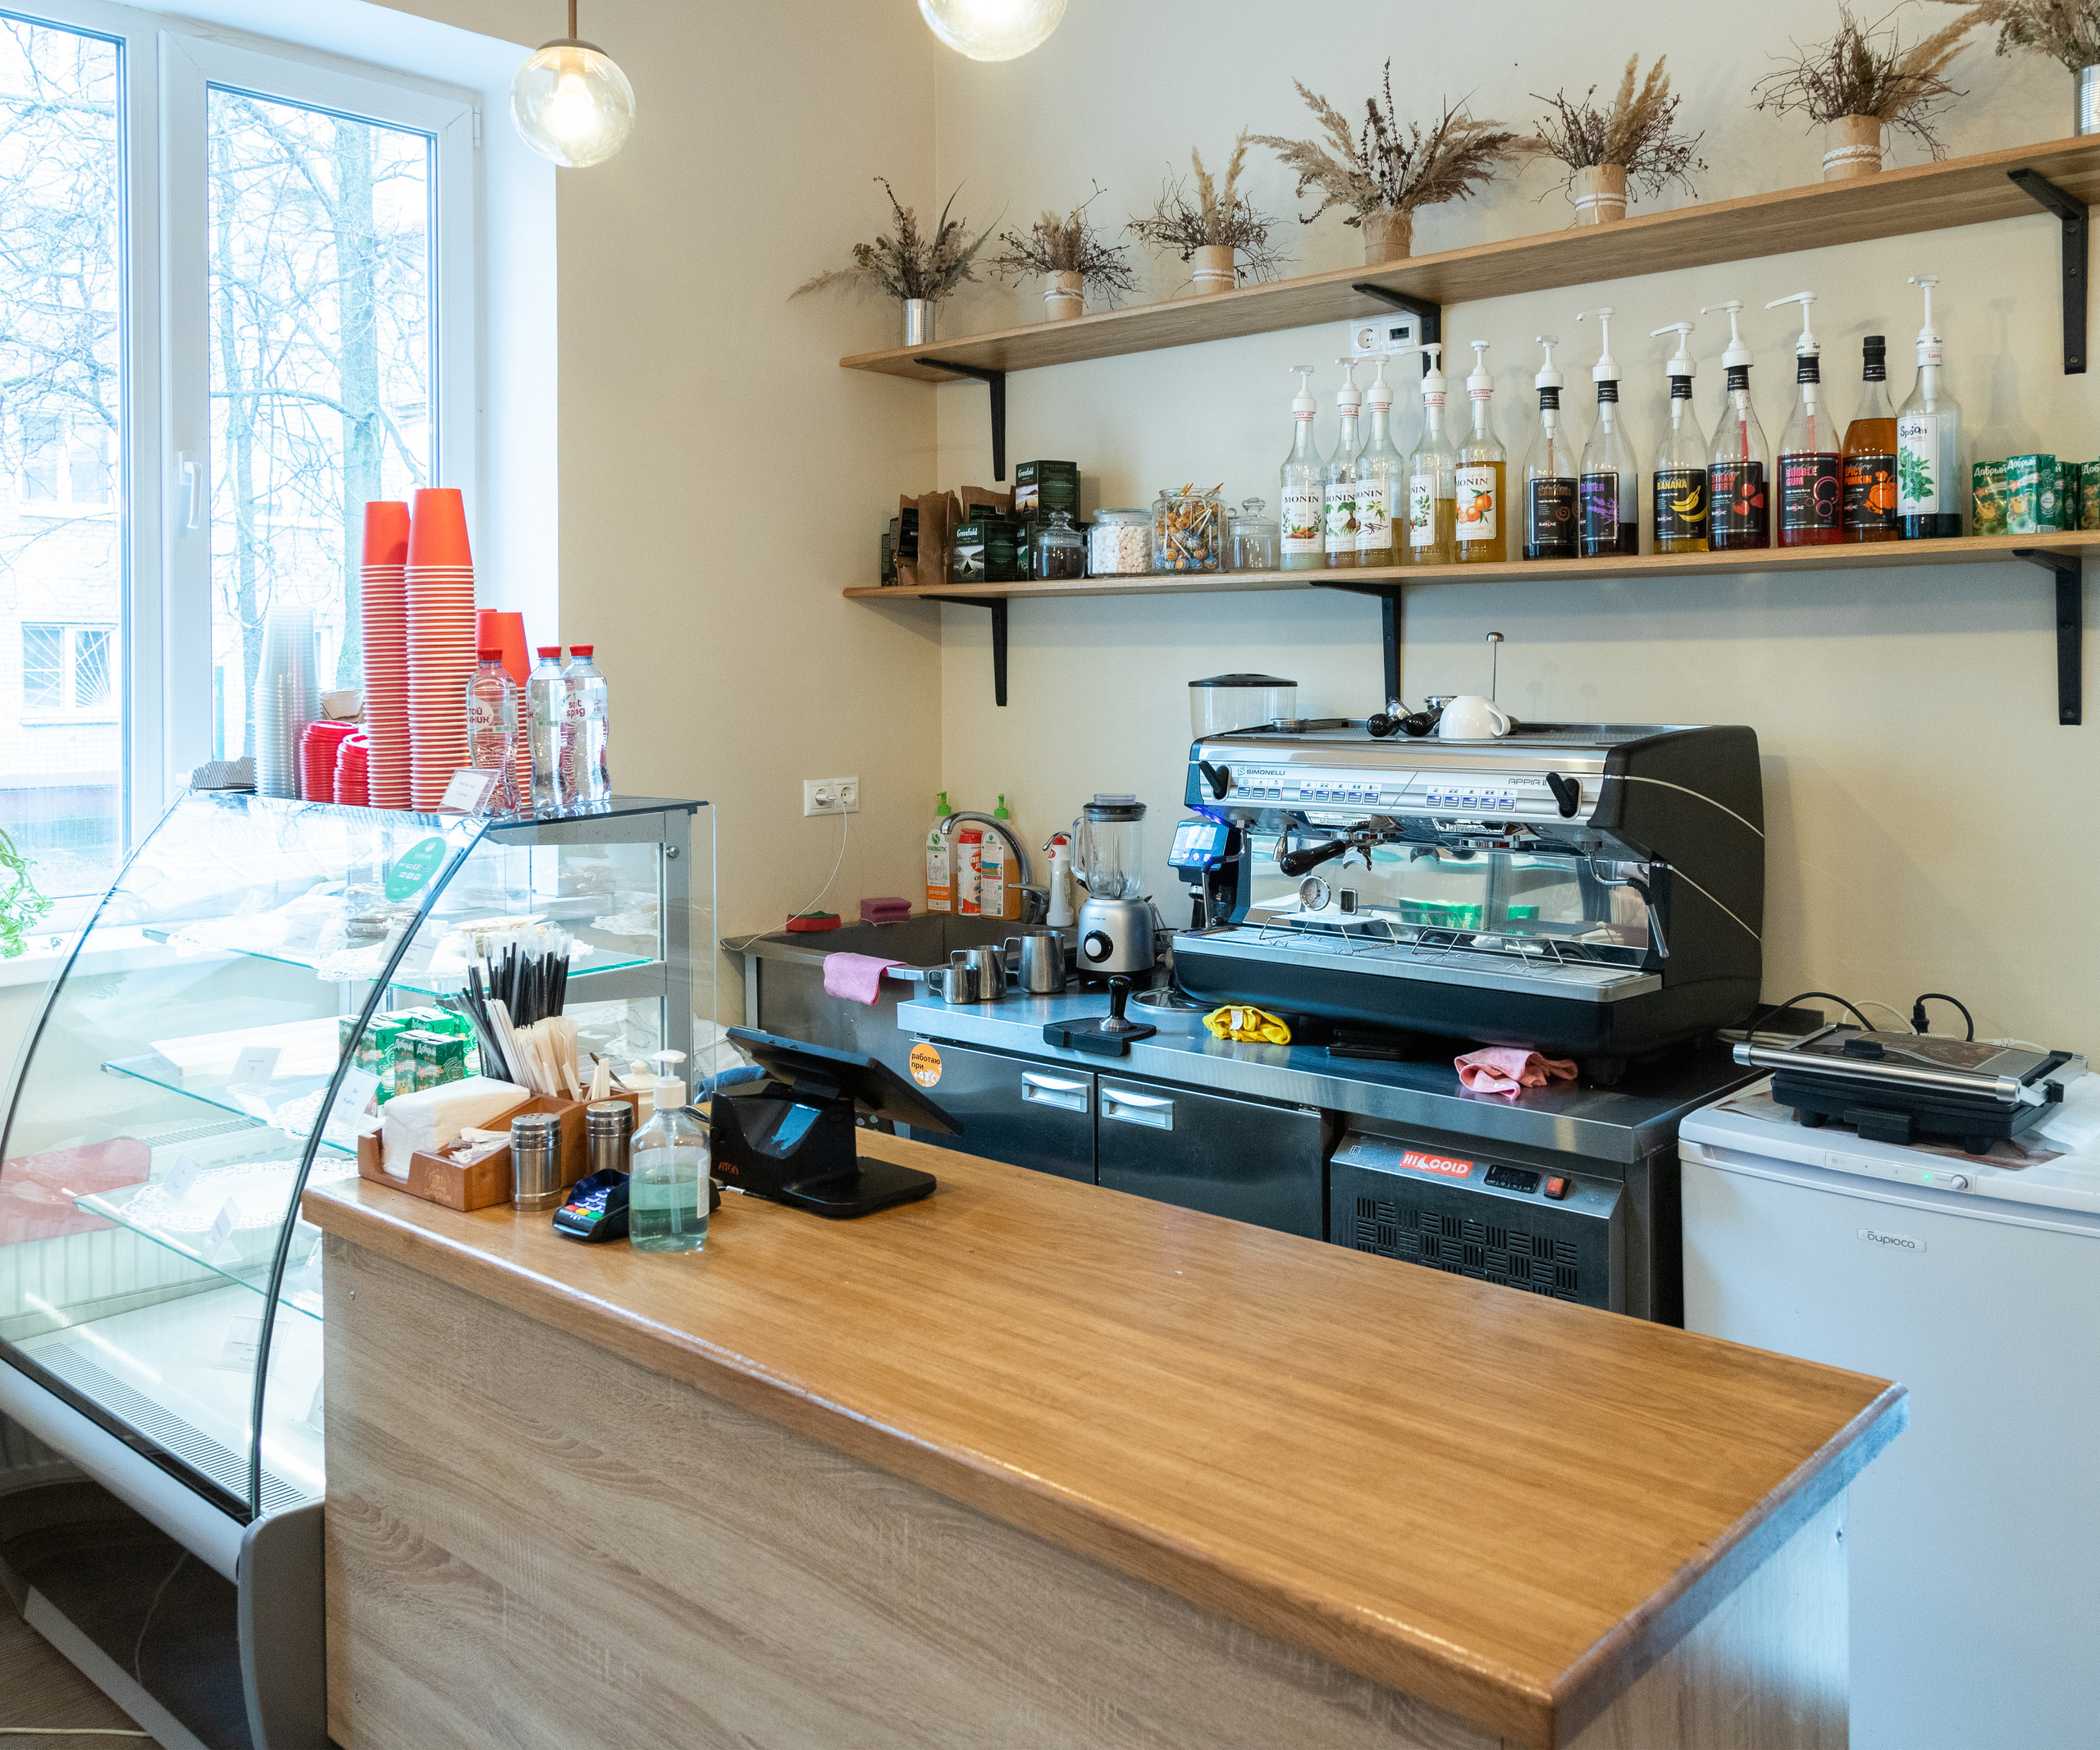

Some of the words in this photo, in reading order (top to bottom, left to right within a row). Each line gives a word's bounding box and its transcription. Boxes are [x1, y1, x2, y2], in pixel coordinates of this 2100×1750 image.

[2006, 456, 2036, 470] Добрый
[1786, 468, 1817, 477] BUBBLE
[1844, 467, 1862, 477] SPICY
[1974, 464, 2007, 477] Добрый
[2083, 464, 2100, 475] Доб
[1711, 474, 1737, 483] STRAW
[1786, 476, 1804, 487] GUM
[1657, 481, 1687, 490] BANANA
[1711, 482, 1733, 492] BERRY
[956, 528, 978, 537] Greenfield
[468, 706, 483, 715] той
[1509, 778, 1541, 786] APPIA
[970, 856, 980, 864] ПЕ
[395, 1038, 414, 1052] Добрый
[417, 1043, 437, 1057] Добрый
[911, 1053, 941, 1065] работаю
[911, 1061, 924, 1070] при
[1867, 1231, 1915, 1249] бирюса
